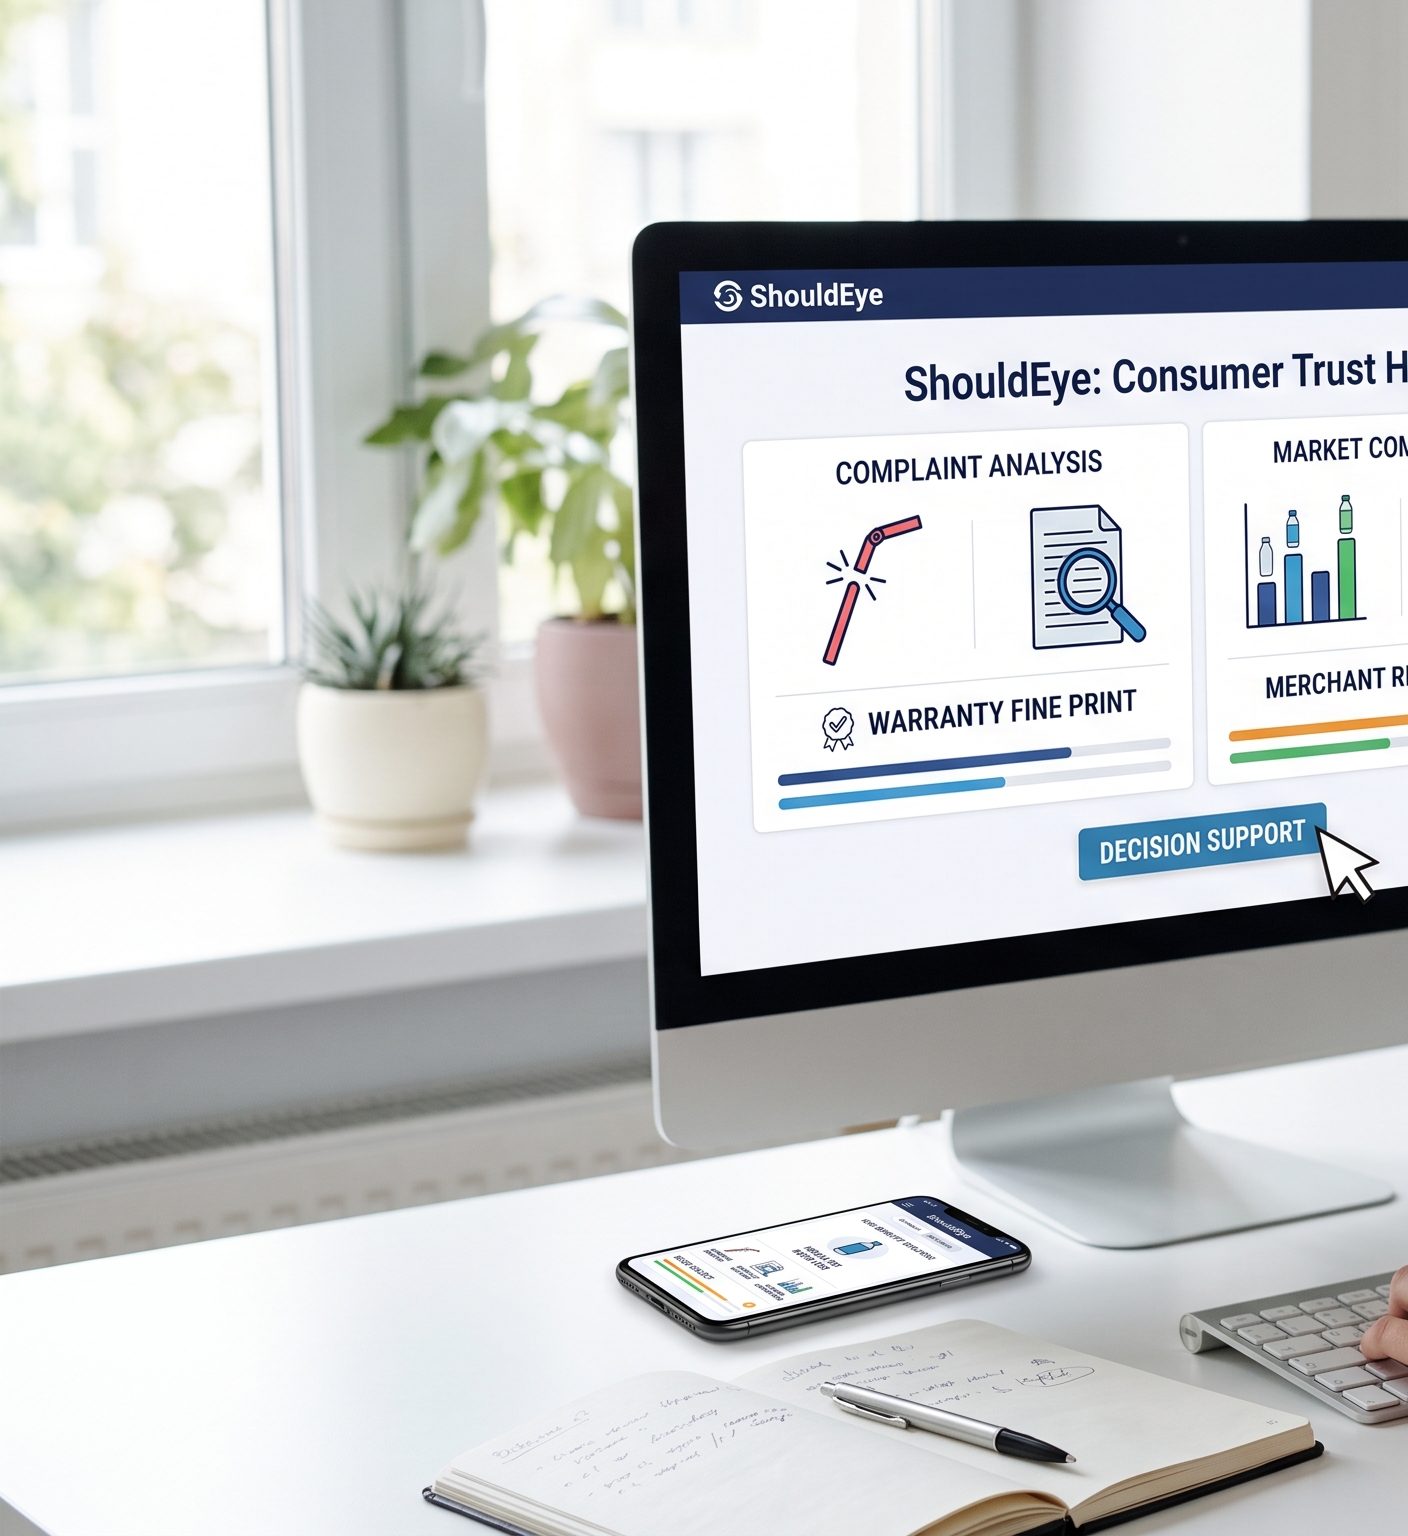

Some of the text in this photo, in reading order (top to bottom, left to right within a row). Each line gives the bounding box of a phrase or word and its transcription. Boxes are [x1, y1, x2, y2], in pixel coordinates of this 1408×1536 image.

[750, 282, 884, 313] ShouldEye
[904, 360, 1101, 407] ShouldEye:
[1112, 358, 1284, 394] Consumer
[1291, 352, 1377, 387] Trust
[836, 449, 1103, 486] COMPLAINT ANALYSIS
[1273, 437, 1363, 464] MARKET
[1265, 666, 1387, 699] MERCHANT
[868, 688, 1137, 736] WARRANTY FINE PRINT
[1099, 818, 1306, 866] DECISION SUPPORT
